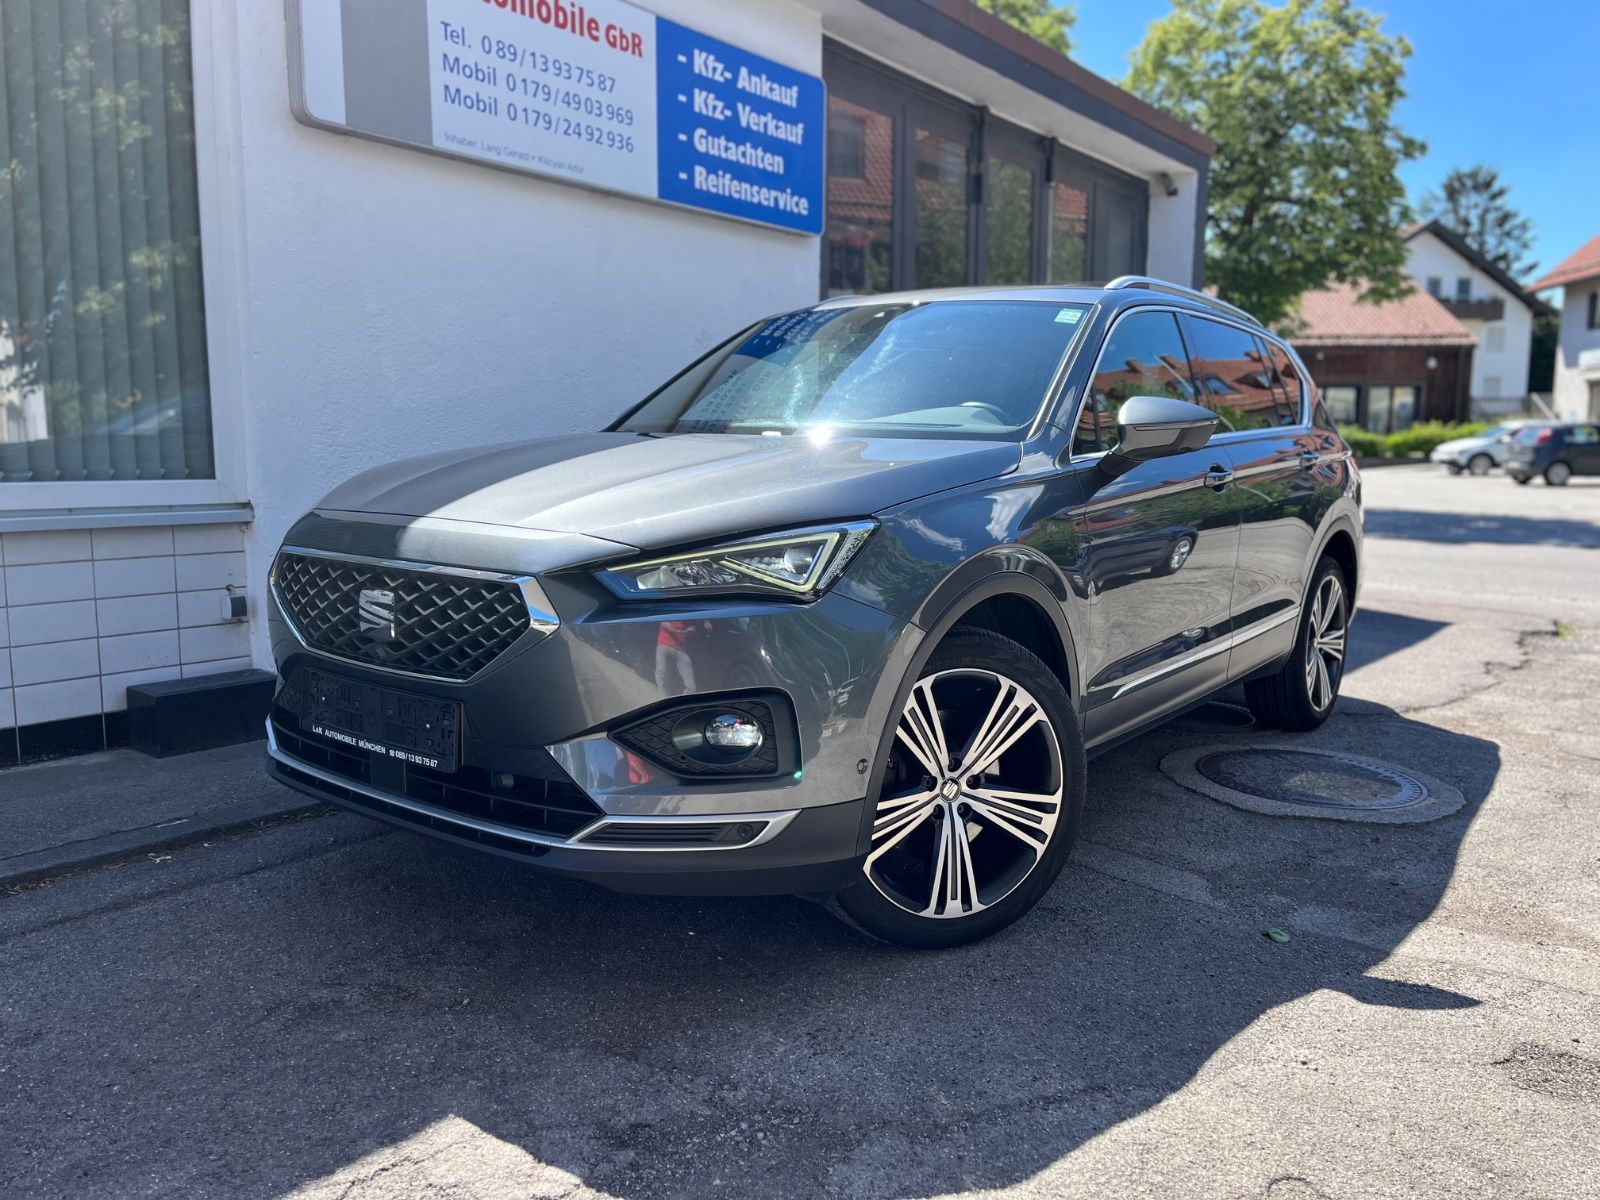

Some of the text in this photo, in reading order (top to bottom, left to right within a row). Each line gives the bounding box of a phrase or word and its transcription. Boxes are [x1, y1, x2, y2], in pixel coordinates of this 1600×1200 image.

[440, 20, 472, 48] Tel.
[605, 23, 643, 58] GbR
[442, 53, 497, 87] Mobil
[736, 66, 799, 108] Ankauf
[443, 84, 498, 117] Mobil
[736, 102, 804, 145] Verkauf
[481, 142, 501, 156] Lang
[693, 127, 785, 175] Gutachten
[693, 164, 809, 216] Reifenservice
[324, 729, 357, 746] AUTOMOBILE
[358, 739, 386, 754] MÜNCHEN
